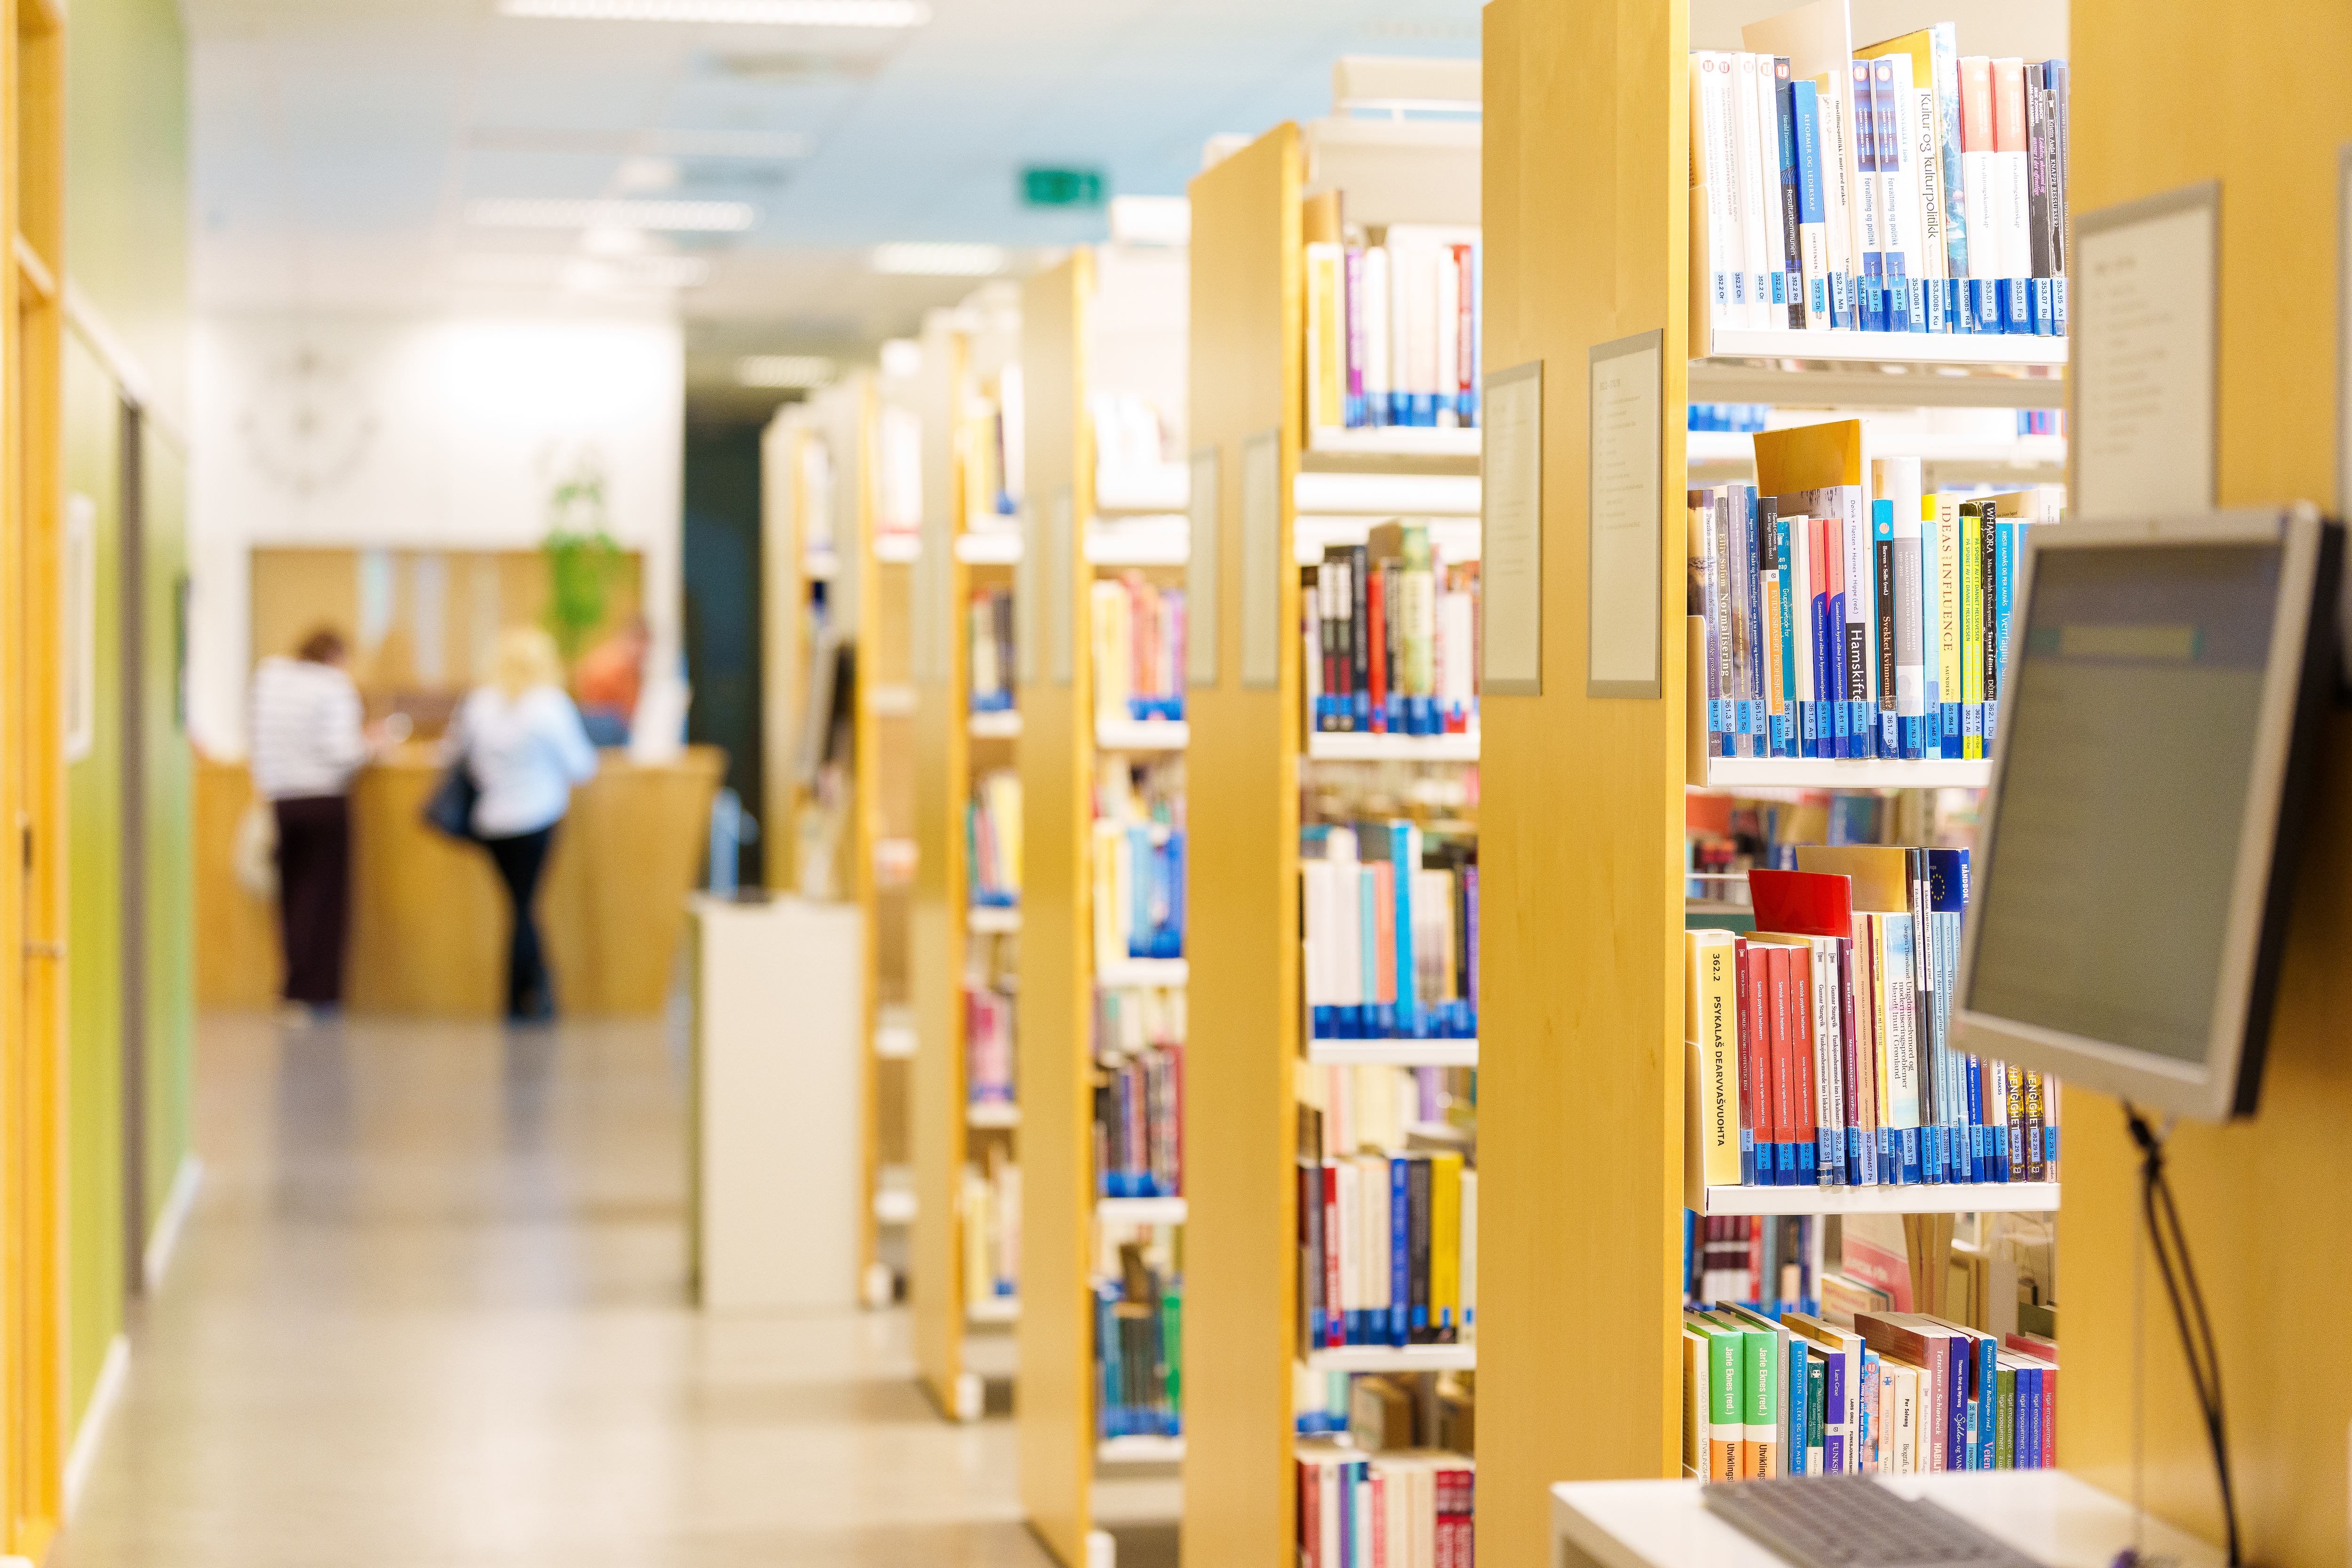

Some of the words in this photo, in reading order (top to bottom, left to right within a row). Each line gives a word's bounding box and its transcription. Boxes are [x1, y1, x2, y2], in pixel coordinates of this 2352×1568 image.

[1921, 94, 1931, 131] Kultur
[1920, 134, 1931, 152] og
[1807, 156, 1813, 167] OG
[1864, 178, 1873, 211] Forvaltning
[1922, 157, 1939, 239] kulturpolitikk
[1787, 189, 1796, 255] Resultatkommunen
[1838, 299, 1844, 310] Ma
[2058, 308, 2063, 317] As
[1933, 316, 1939, 326] Ku
[1965, 316, 1971, 325] Rå
[1942, 506, 1952, 552] IDEAS
[1771, 590, 1780, 652] EVIDENSBASERT
[1942, 563, 1953, 651] INFLUENCE
[1720, 592, 1731, 677] Normalisering
[2000, 611, 2010, 663] Tverrfaglig
[1884, 653, 1892, 708] kvinnemakt?
[1809, 727, 1813, 737] An
[1988, 727, 1994, 736] Du
[1714, 996, 1724, 1047] PSYKALAŠ
[1898, 982, 1908, 1089] moderniseringsproblemer
[1905, 981, 1915, 1059] Ungdomsselvmord
[1907, 1061, 1914, 1071] og
[1716, 1051, 1726, 1146] DEARVVAŠVUOHTA
[1725, 1346, 1734, 1366] Jarle
[1726, 1368, 1734, 1391] Eknes
[1725, 1393, 1735, 1415] (red.)
[1796, 1423, 1801, 1432] OG
[1954, 1413, 1966, 1444] Sjelden
[1984, 1441, 1993, 1469] Veien
